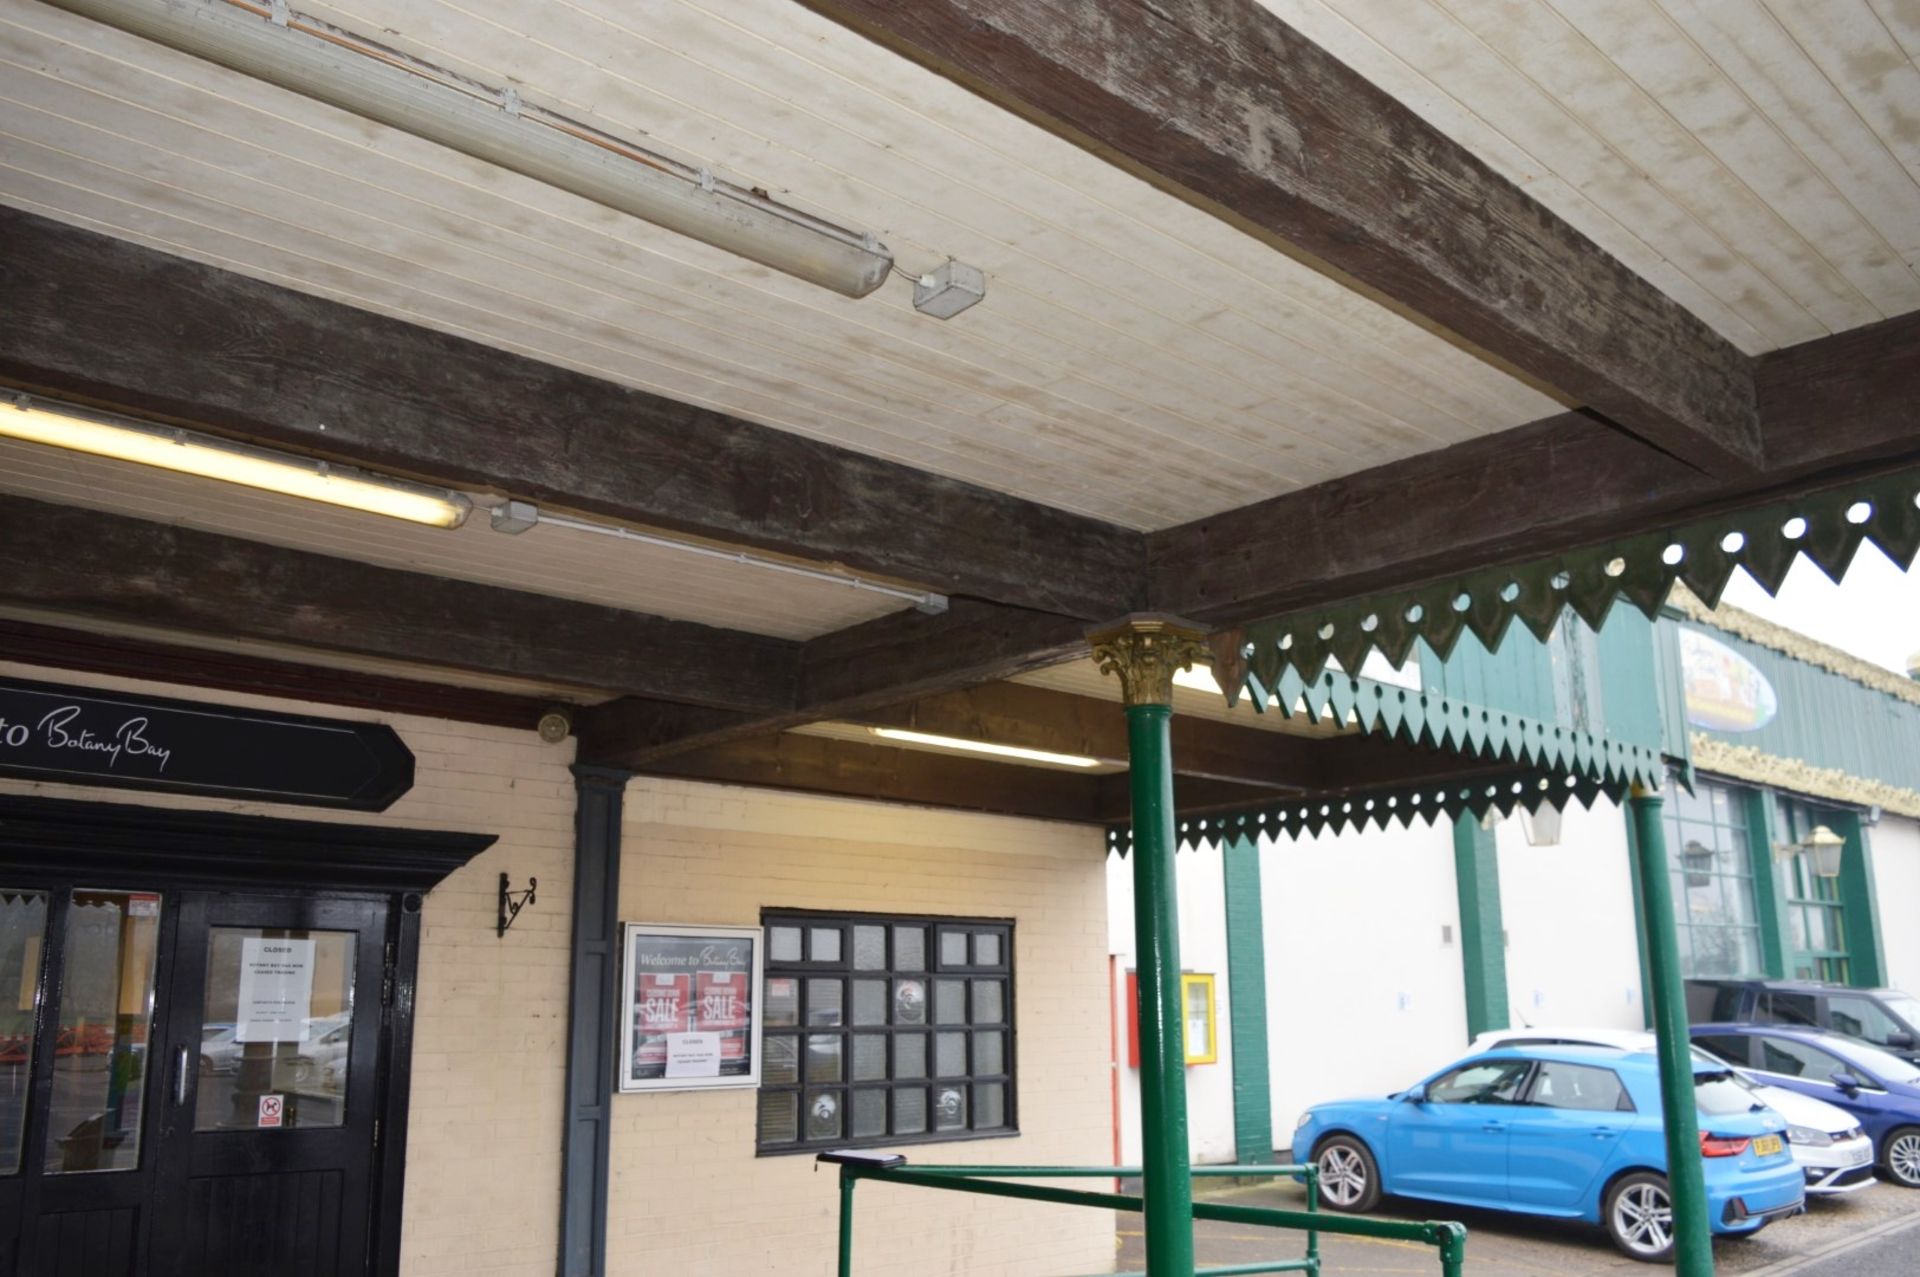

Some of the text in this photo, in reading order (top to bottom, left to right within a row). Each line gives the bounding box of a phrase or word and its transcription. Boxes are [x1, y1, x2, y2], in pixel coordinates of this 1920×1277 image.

[37, 706, 121, 767] Botany
[116, 717, 171, 772] Bay
[641, 953, 687, 966] Welcome
[688, 955, 700, 966] to
[646, 998, 680, 1022] SALE
[703, 995, 737, 1020] SALE
